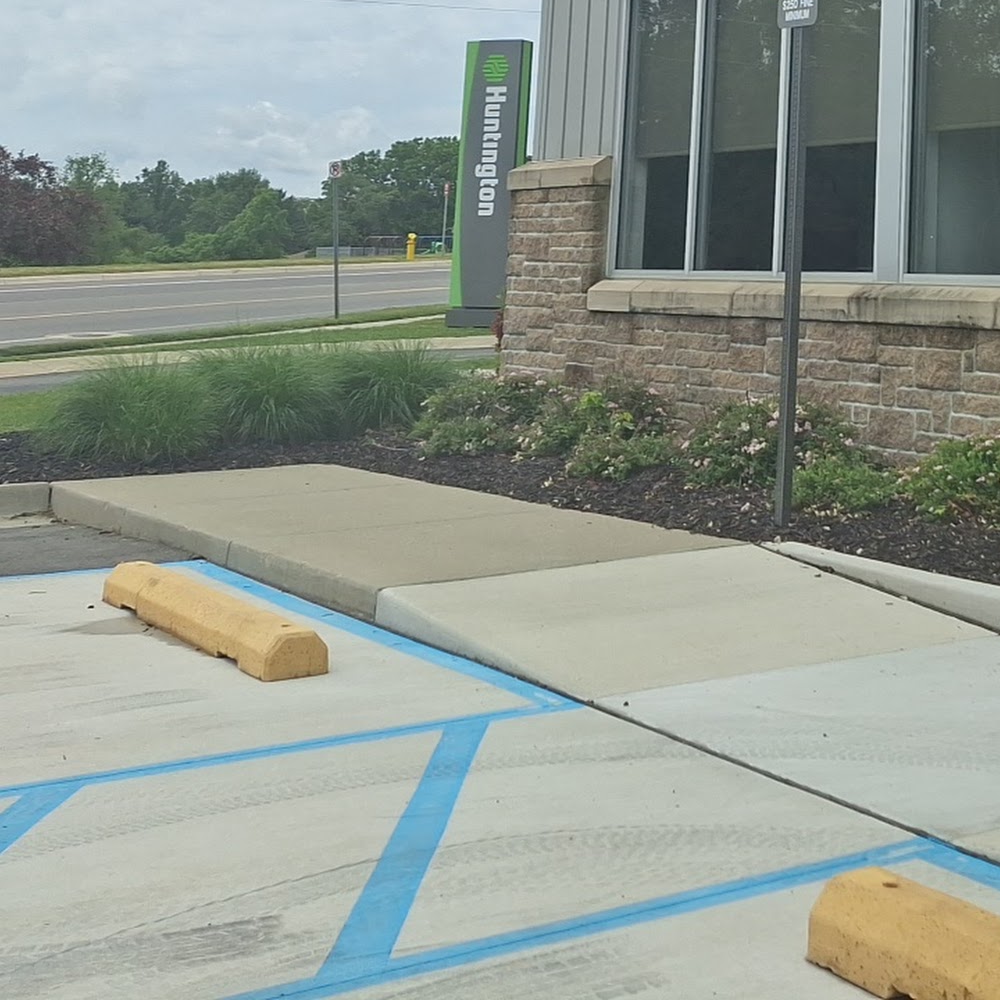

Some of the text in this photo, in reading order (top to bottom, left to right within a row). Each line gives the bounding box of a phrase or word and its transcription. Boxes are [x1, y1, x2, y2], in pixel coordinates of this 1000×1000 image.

[782, 0, 799, 10] $250
[785, 8, 810, 21] MINIMUM
[475, 85, 508, 217] Huntington
